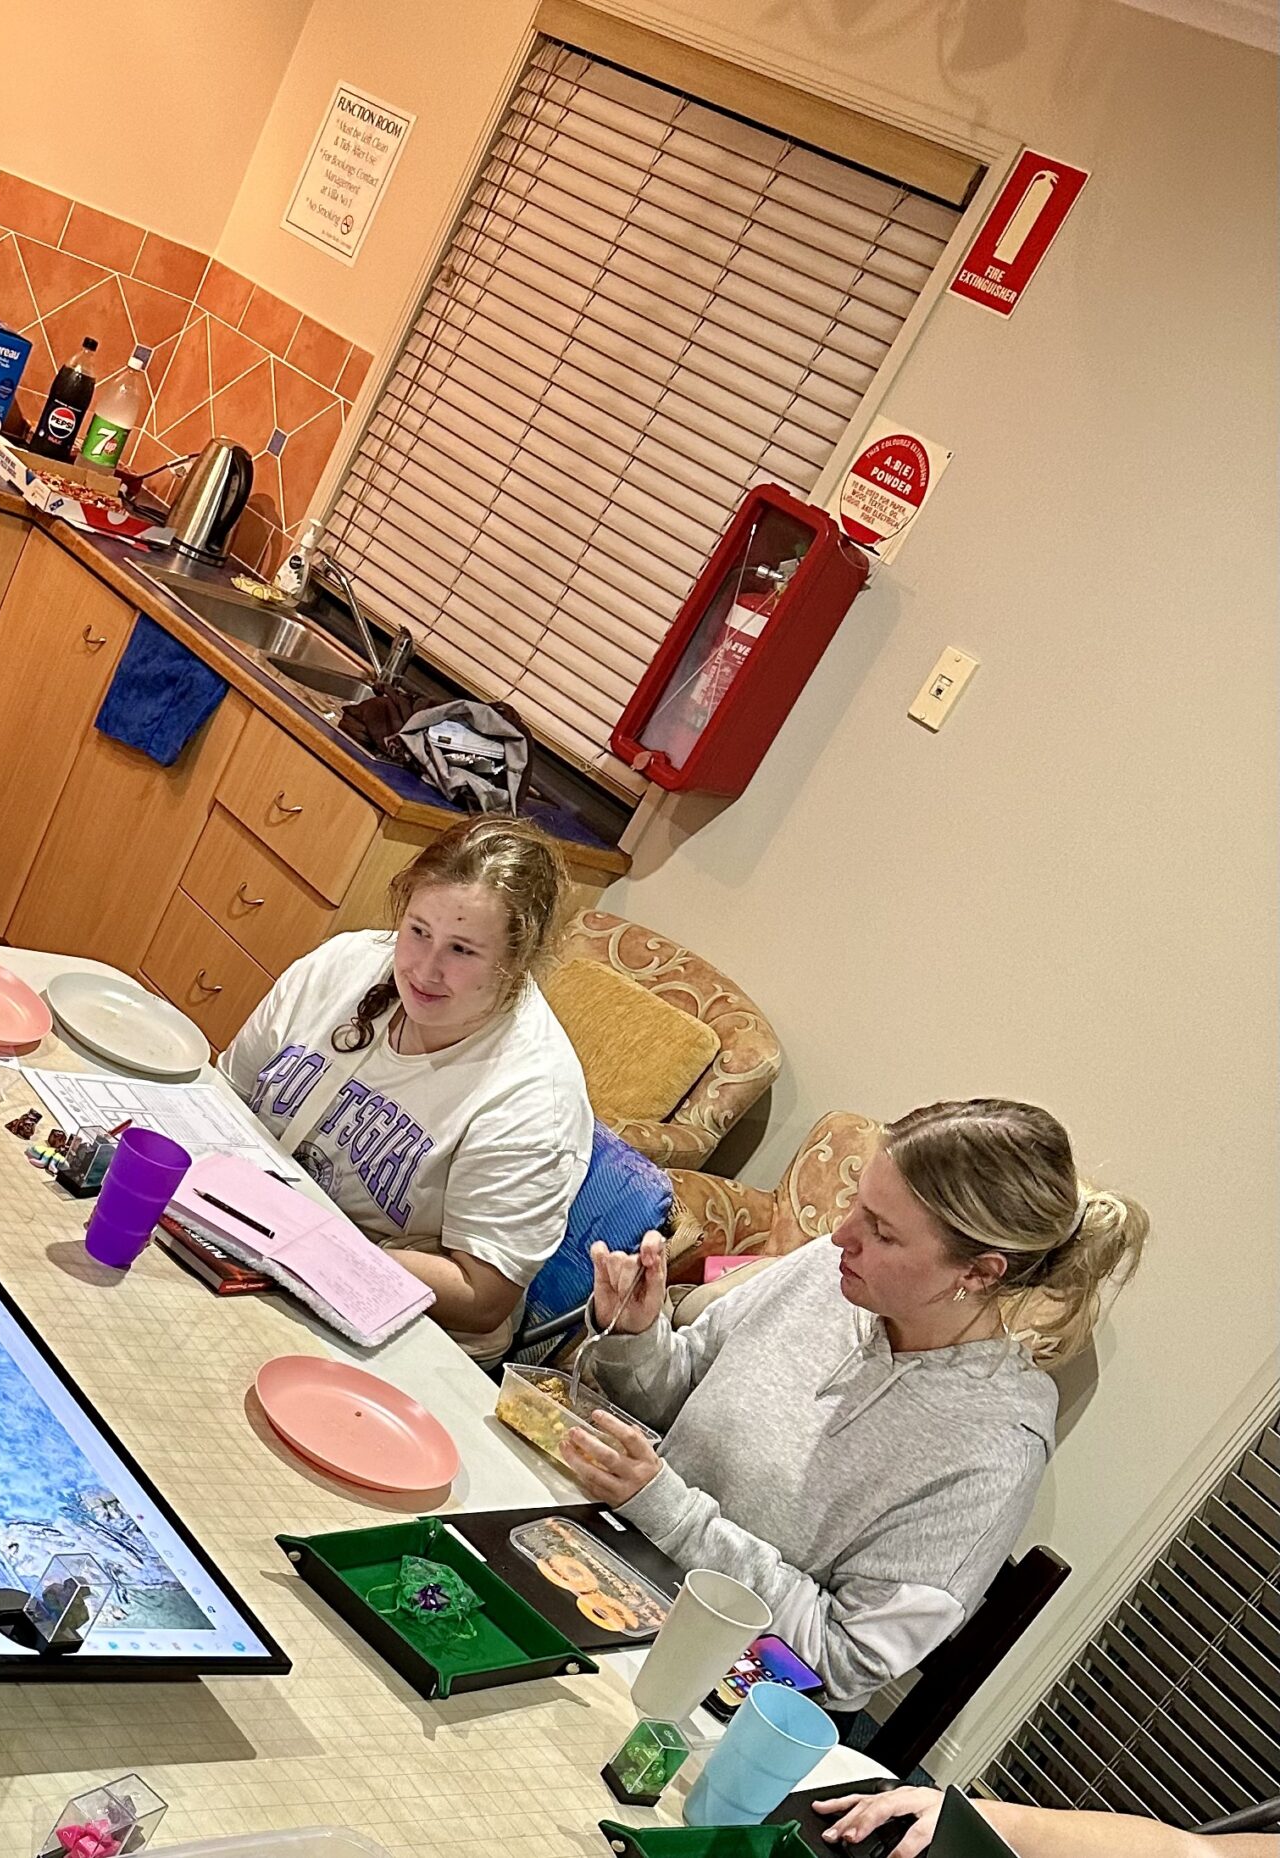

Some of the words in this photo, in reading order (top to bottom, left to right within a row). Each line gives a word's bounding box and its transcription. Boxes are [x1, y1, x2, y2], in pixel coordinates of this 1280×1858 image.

[337, 96, 376, 125] FUNCTION
[375, 115, 403, 138] ROOM
[958, 269, 1018, 304] EXTINGUISHER
[984, 265, 1006, 283] FIRE
[870, 466, 912, 495] POWDER
